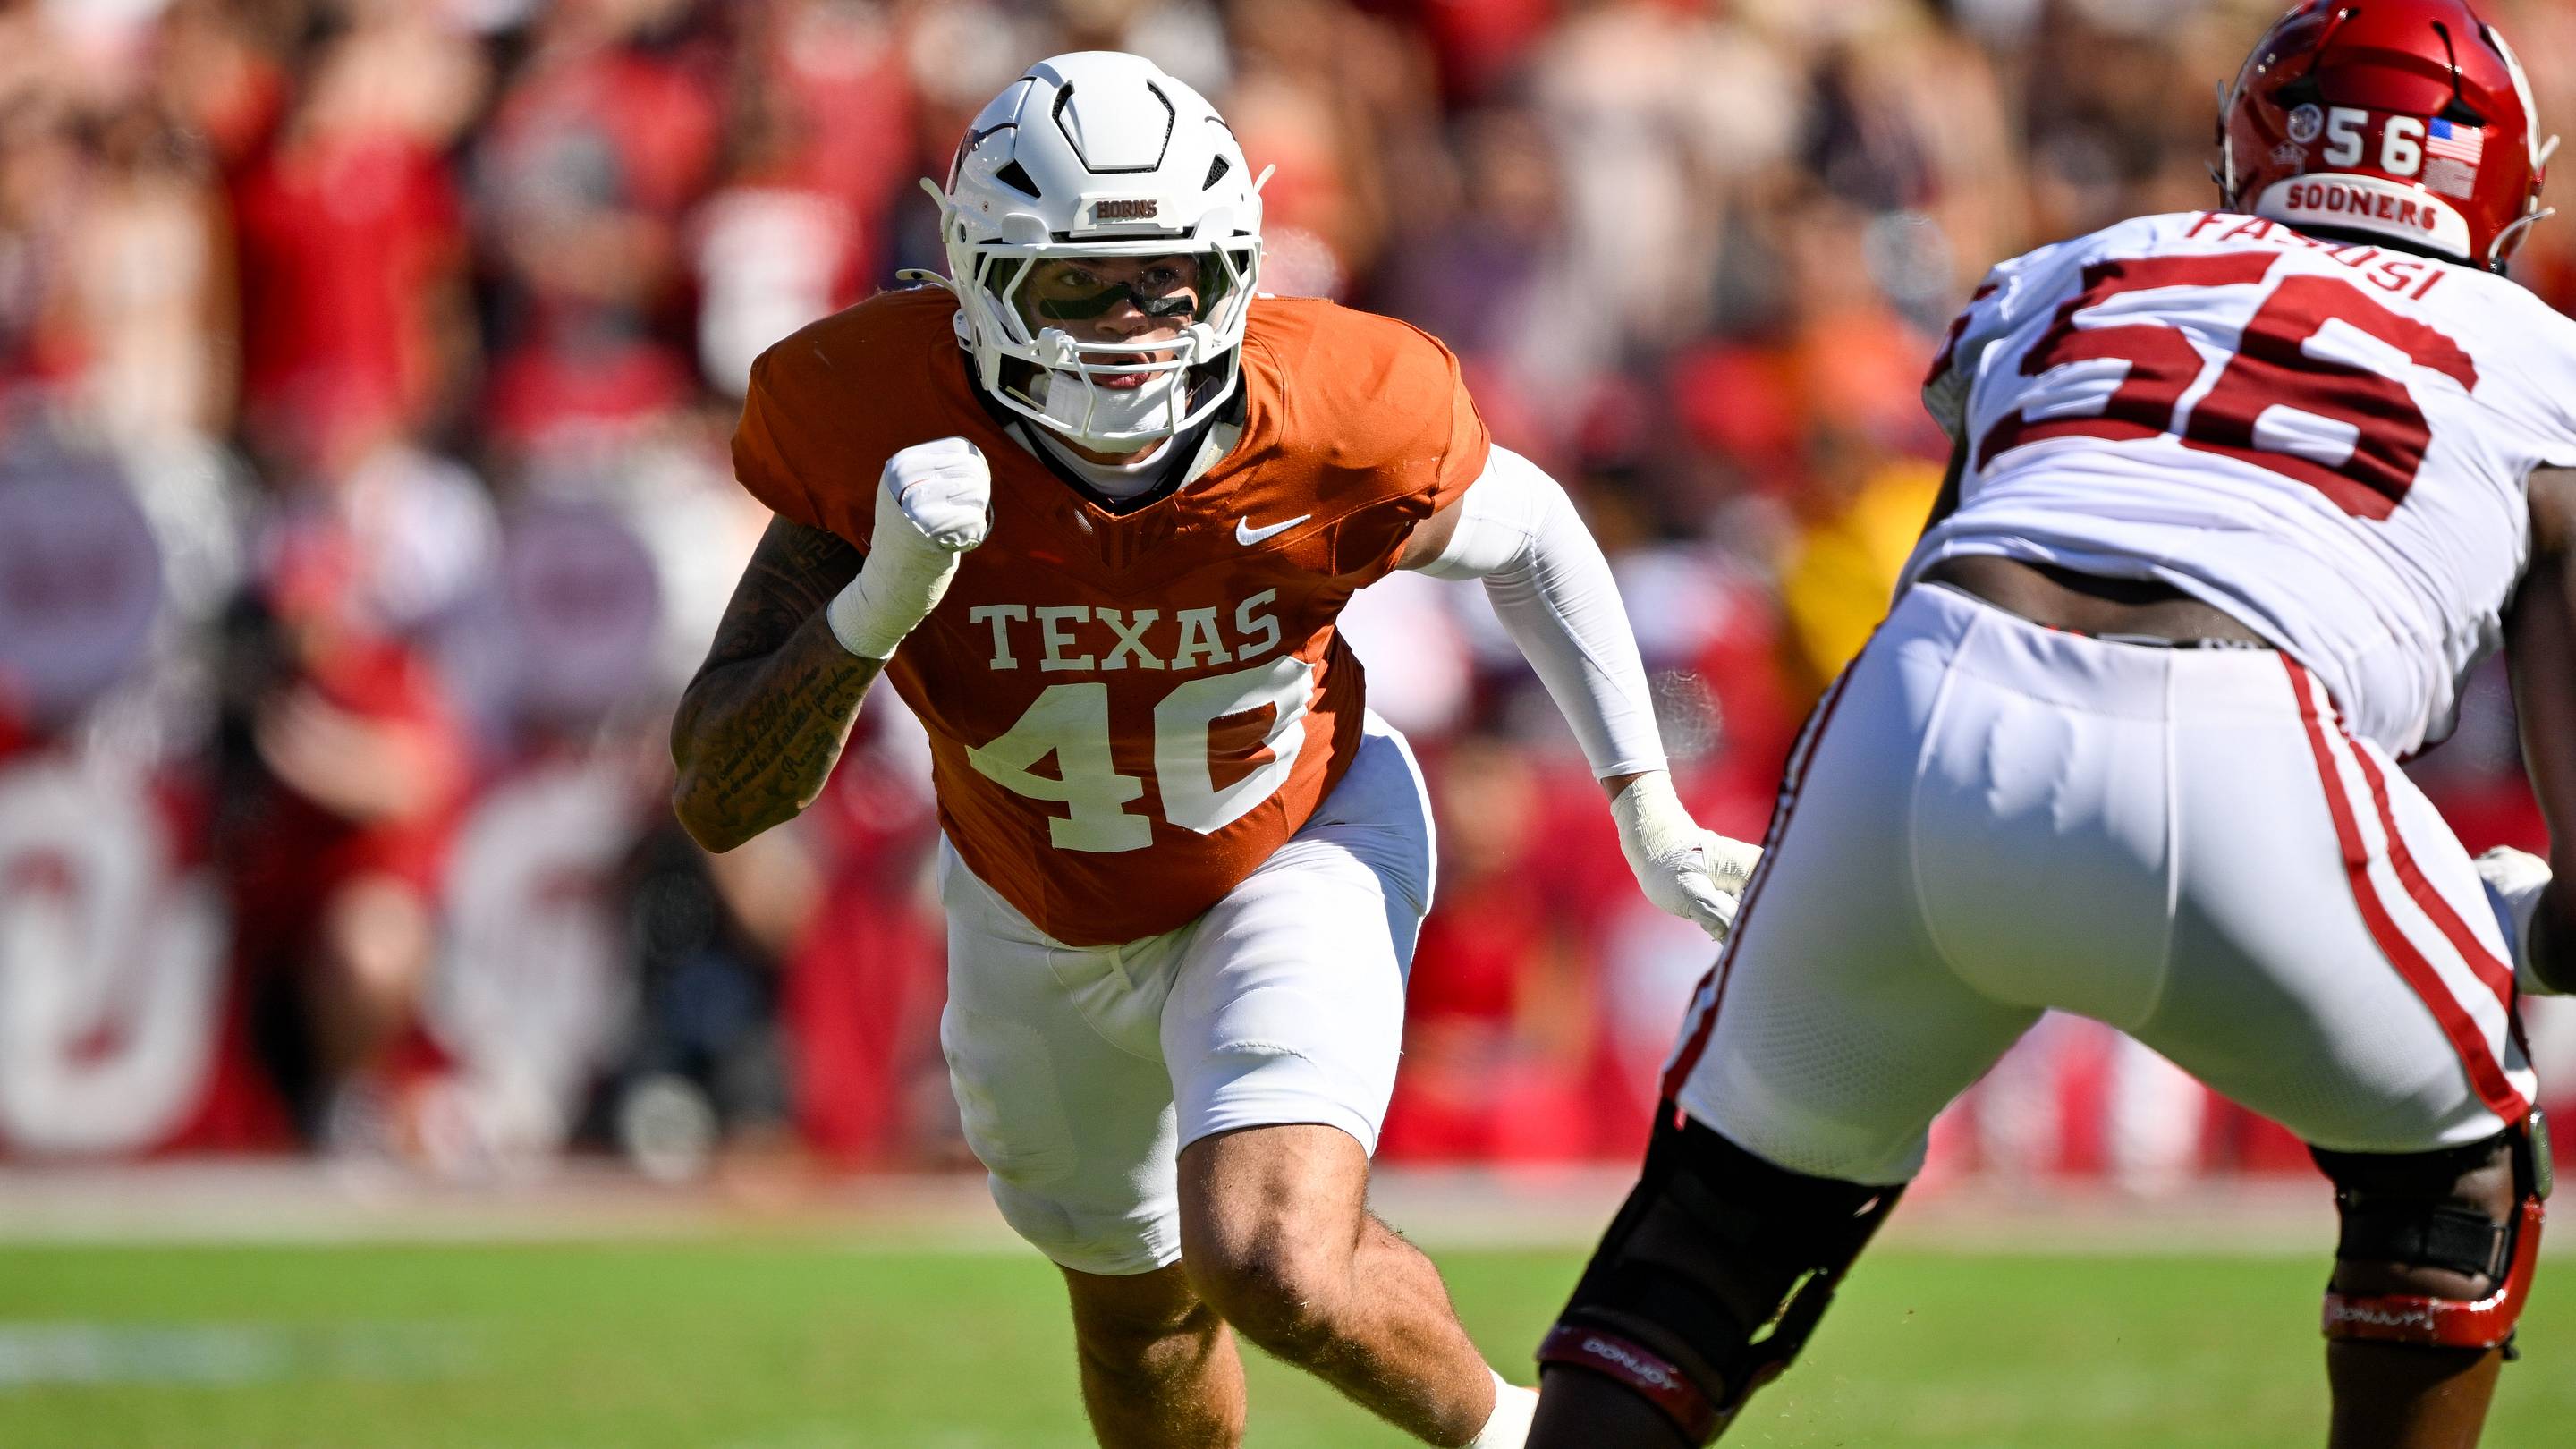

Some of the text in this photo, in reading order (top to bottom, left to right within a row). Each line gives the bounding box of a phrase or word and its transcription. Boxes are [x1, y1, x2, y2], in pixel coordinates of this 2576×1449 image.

[2323, 106, 2425, 177] 56
[1097, 199, 1158, 219] HORNS
[2286, 183, 2436, 230] SOONERS
[1975, 250, 2479, 521] 56
[969, 588, 1281, 672] TEXAS
[964, 655, 1316, 853] 40
